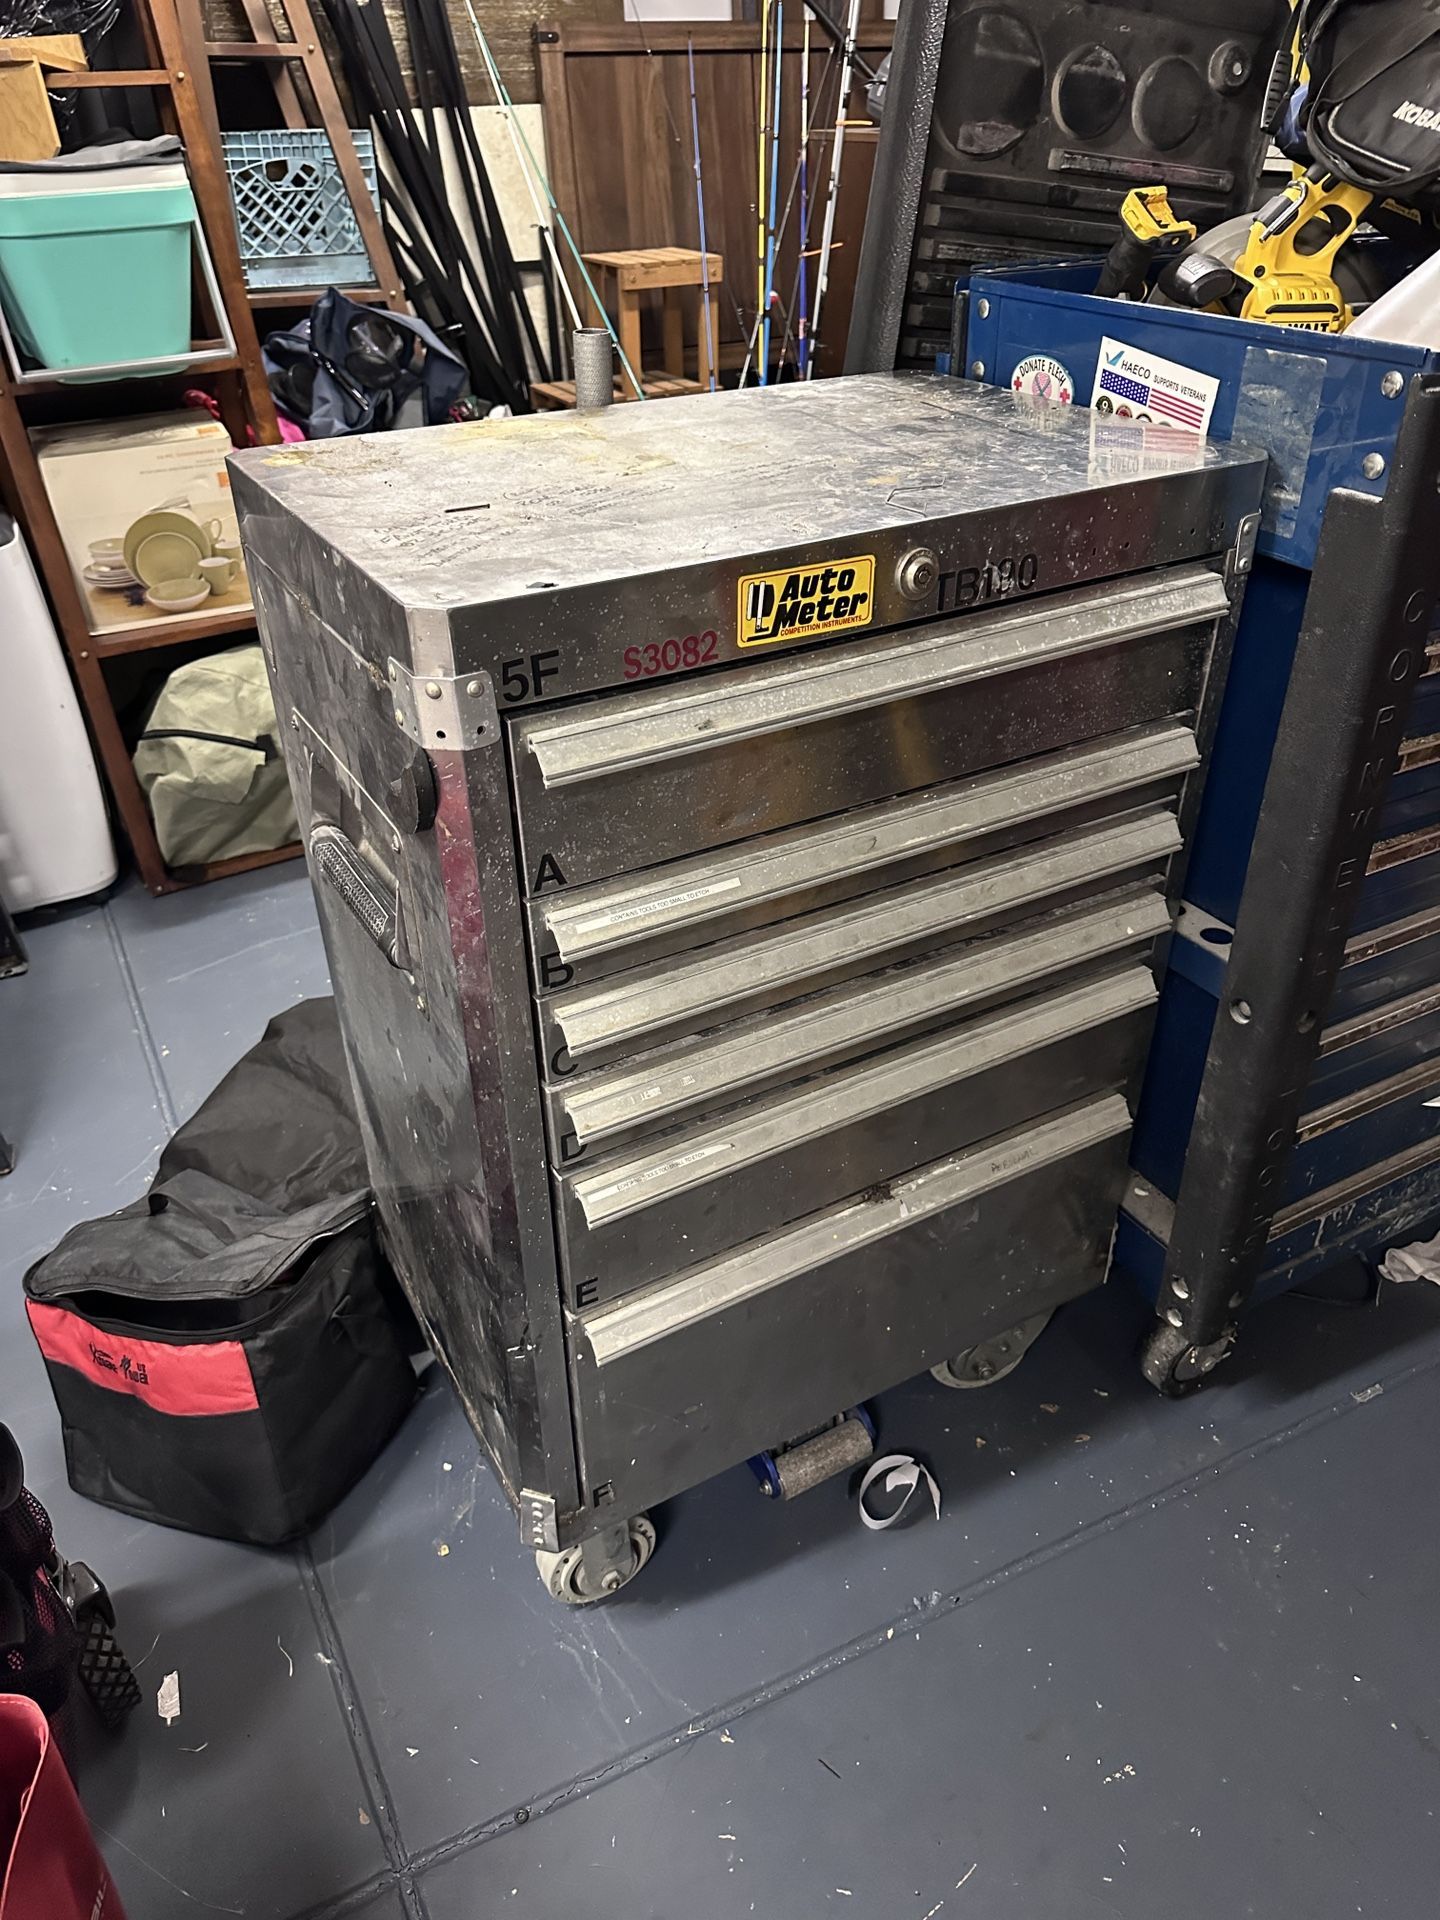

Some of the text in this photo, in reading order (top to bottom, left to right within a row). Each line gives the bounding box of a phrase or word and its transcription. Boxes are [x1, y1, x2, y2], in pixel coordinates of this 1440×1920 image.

[1019, 359, 1067, 387] DONATE FLESH
[1121, 360, 1206, 402] HAECO SUPPORTS VETERANS
[779, 568, 855, 603] Auto
[772, 592, 868, 636] Meter
[781, 615, 862, 637] COMPETITION INSTRUMENTS
[624, 630, 718, 679] S3082
[503, 650, 559, 702] 5F
[534, 853, 567, 892] A
[610, 910, 638, 922] CONTAINS
[640, 905, 657, 914] TOOLS
[551, 1046, 579, 1075] C
[561, 1132, 588, 1162] D
[576, 1277, 598, 1308] E
[593, 1481, 612, 1508] F
